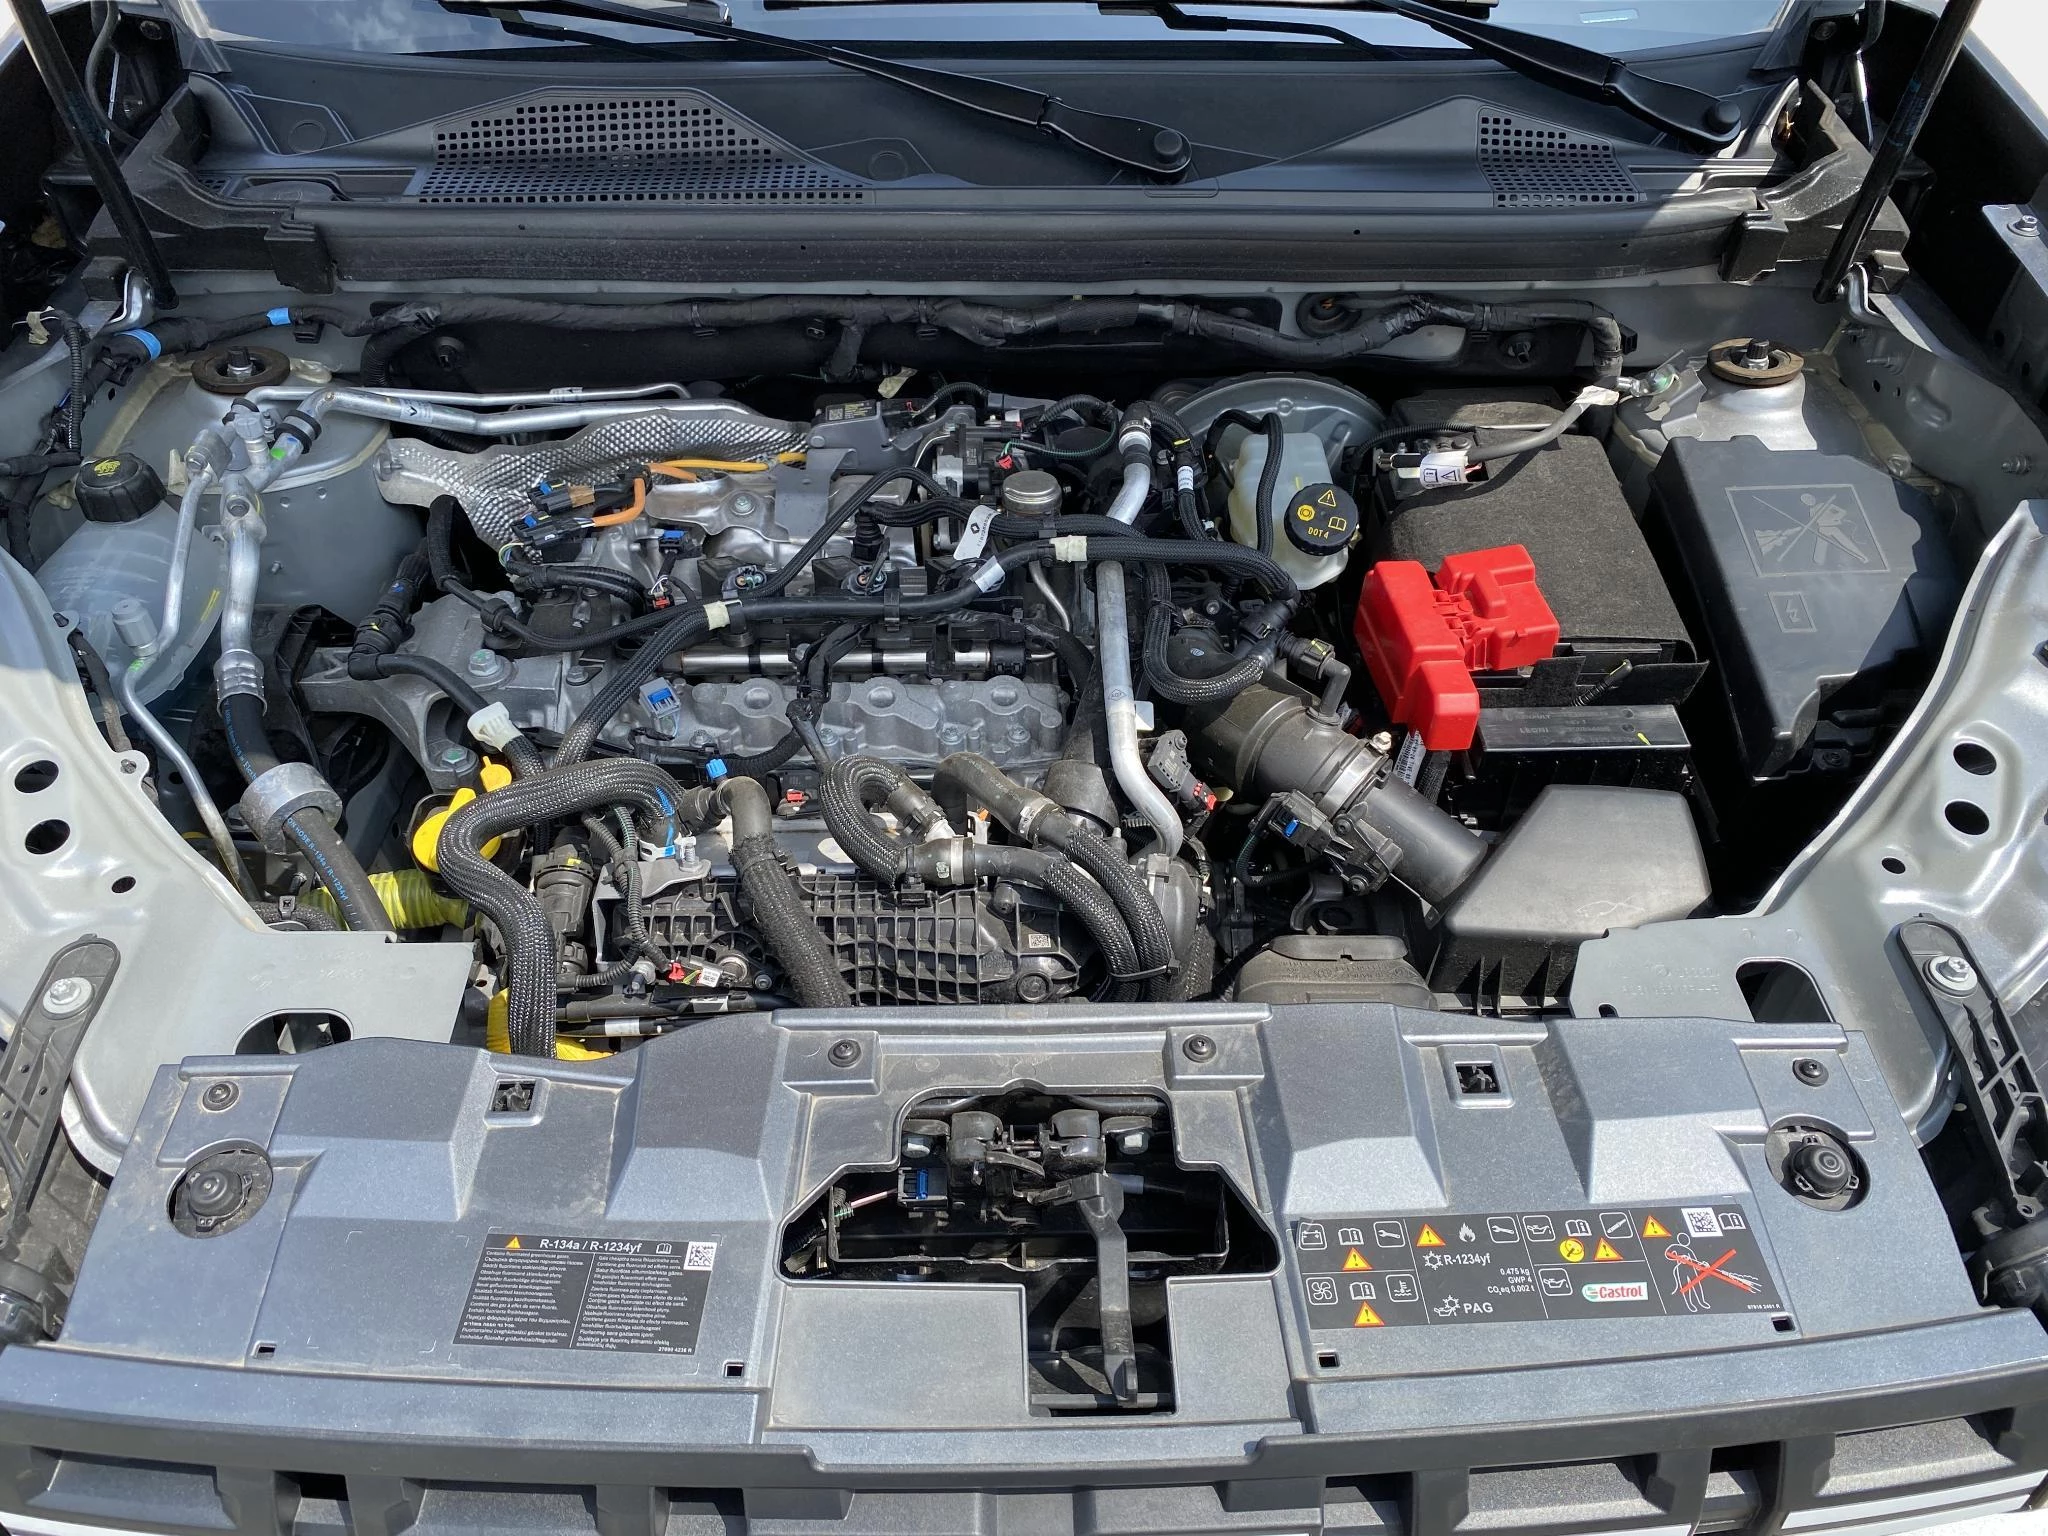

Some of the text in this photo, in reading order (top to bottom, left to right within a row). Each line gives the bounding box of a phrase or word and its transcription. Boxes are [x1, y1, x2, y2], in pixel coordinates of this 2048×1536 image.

[540, 1238, 642, 1254] R-134a / R-1234yf
[1443, 1253, 1491, 1266] R-1234yf
[1500, 1267, 1530, 1277] 0.475 kg
[1508, 1275, 1526, 1284] GWP
[1511, 1285, 1529, 1293] 0.002
[1599, 1285, 1642, 1299] Castrol
[1463, 1302, 1494, 1314] PAG
